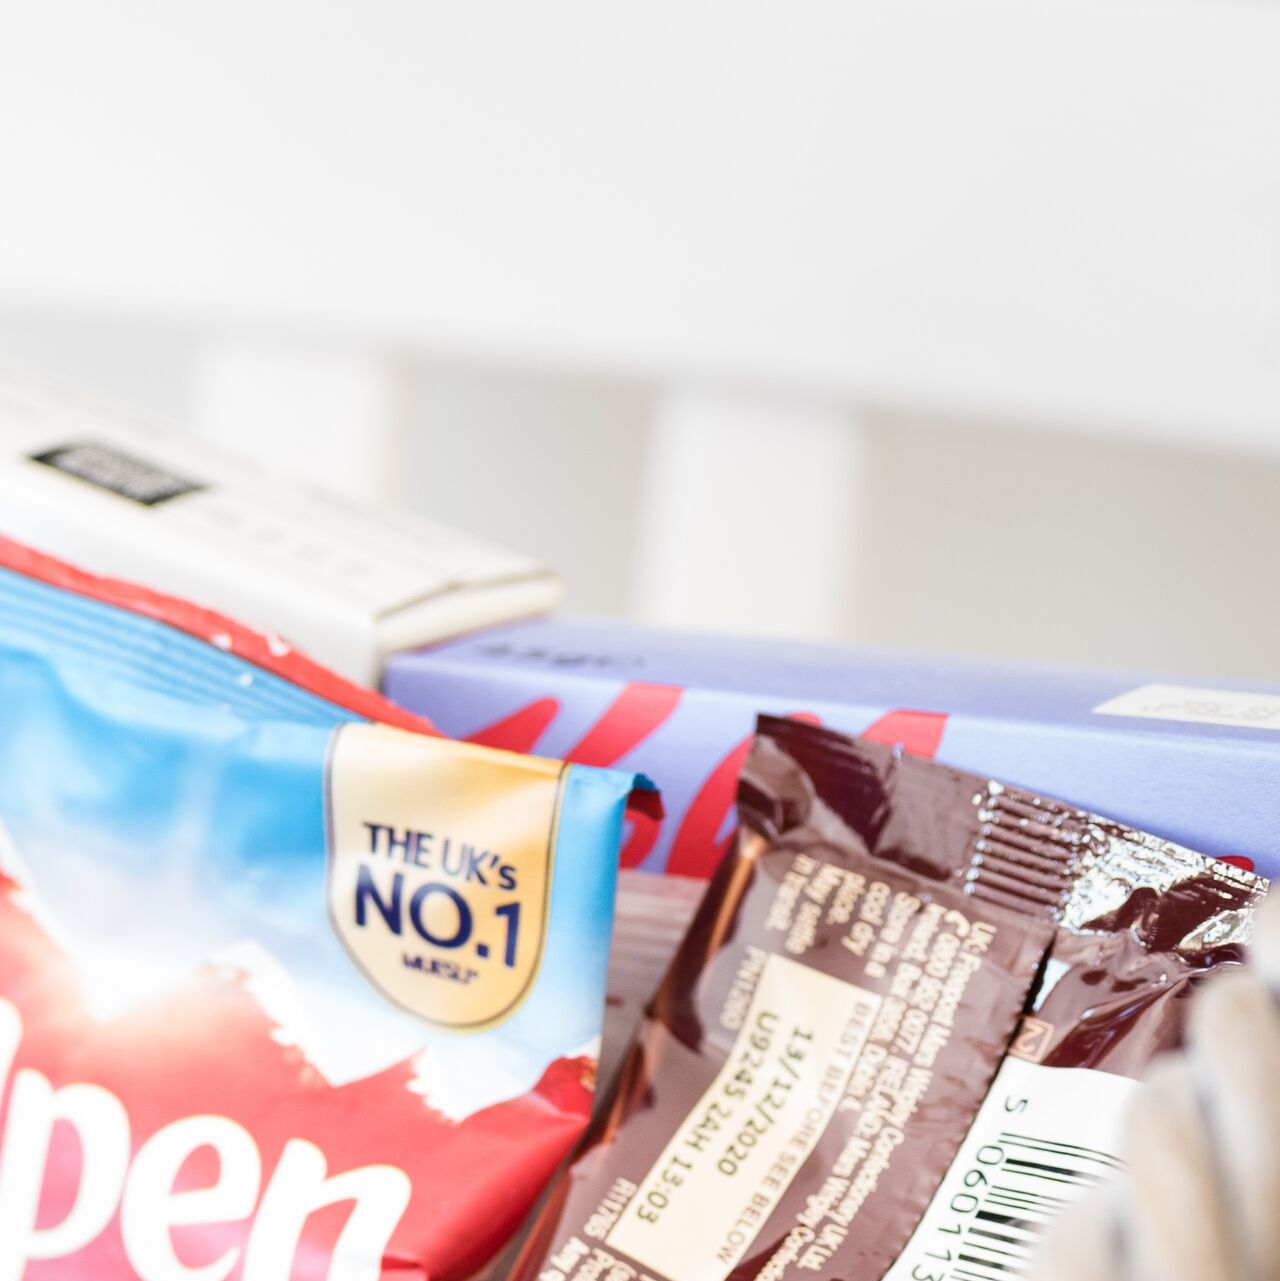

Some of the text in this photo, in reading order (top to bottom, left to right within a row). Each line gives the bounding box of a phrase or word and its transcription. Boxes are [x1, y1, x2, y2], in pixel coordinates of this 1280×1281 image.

[363, 821, 517, 891] THE UK's
[355, 863, 520, 968] NO.1
[713, 1019, 821, 1187] 13/12/2020
[713, 999, 876, 1270] BEST BEFORE SEE BELOW
[632, 1148, 695, 1231] 13:03
